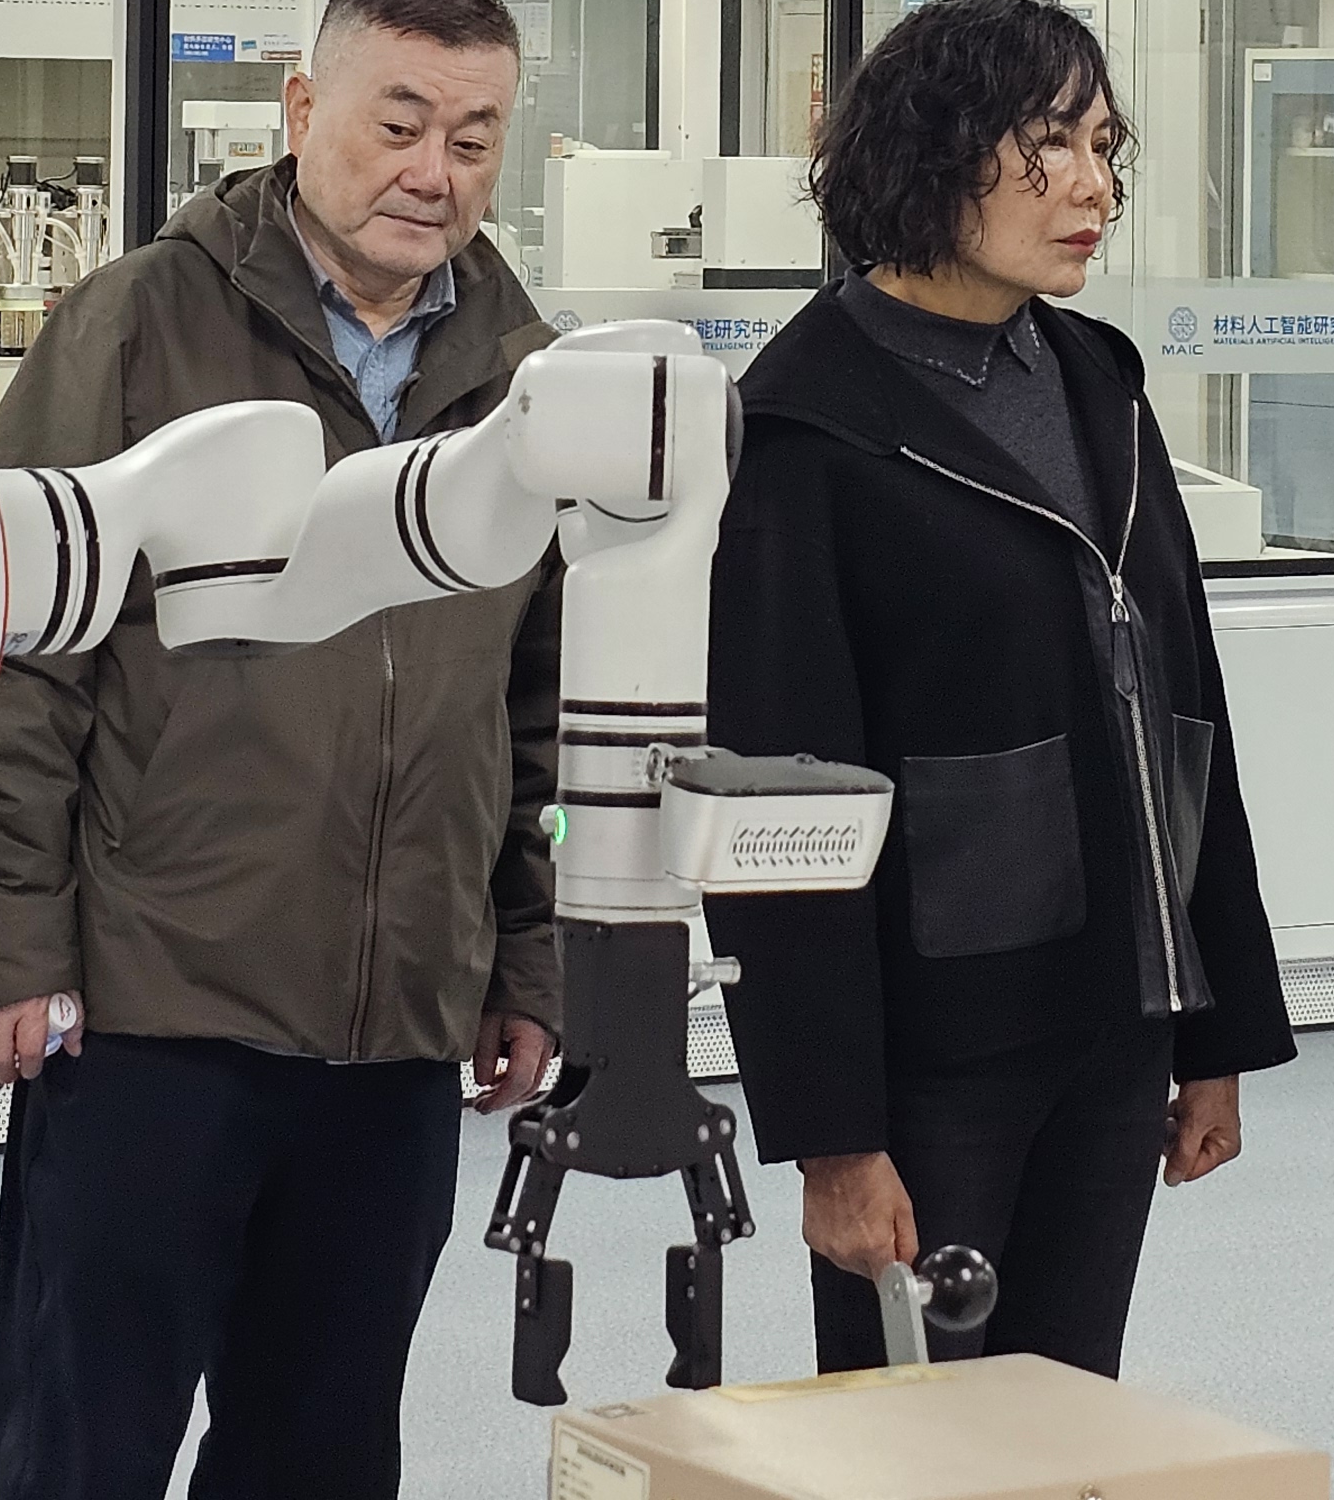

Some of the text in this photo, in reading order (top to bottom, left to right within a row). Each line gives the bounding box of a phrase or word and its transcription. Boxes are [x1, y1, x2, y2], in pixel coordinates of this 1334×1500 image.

[1213, 337, 1255, 346] MATERIALS
[1256, 337, 1296, 346] ARTIFICIAL
[1161, 344, 1204, 356] MAIC
